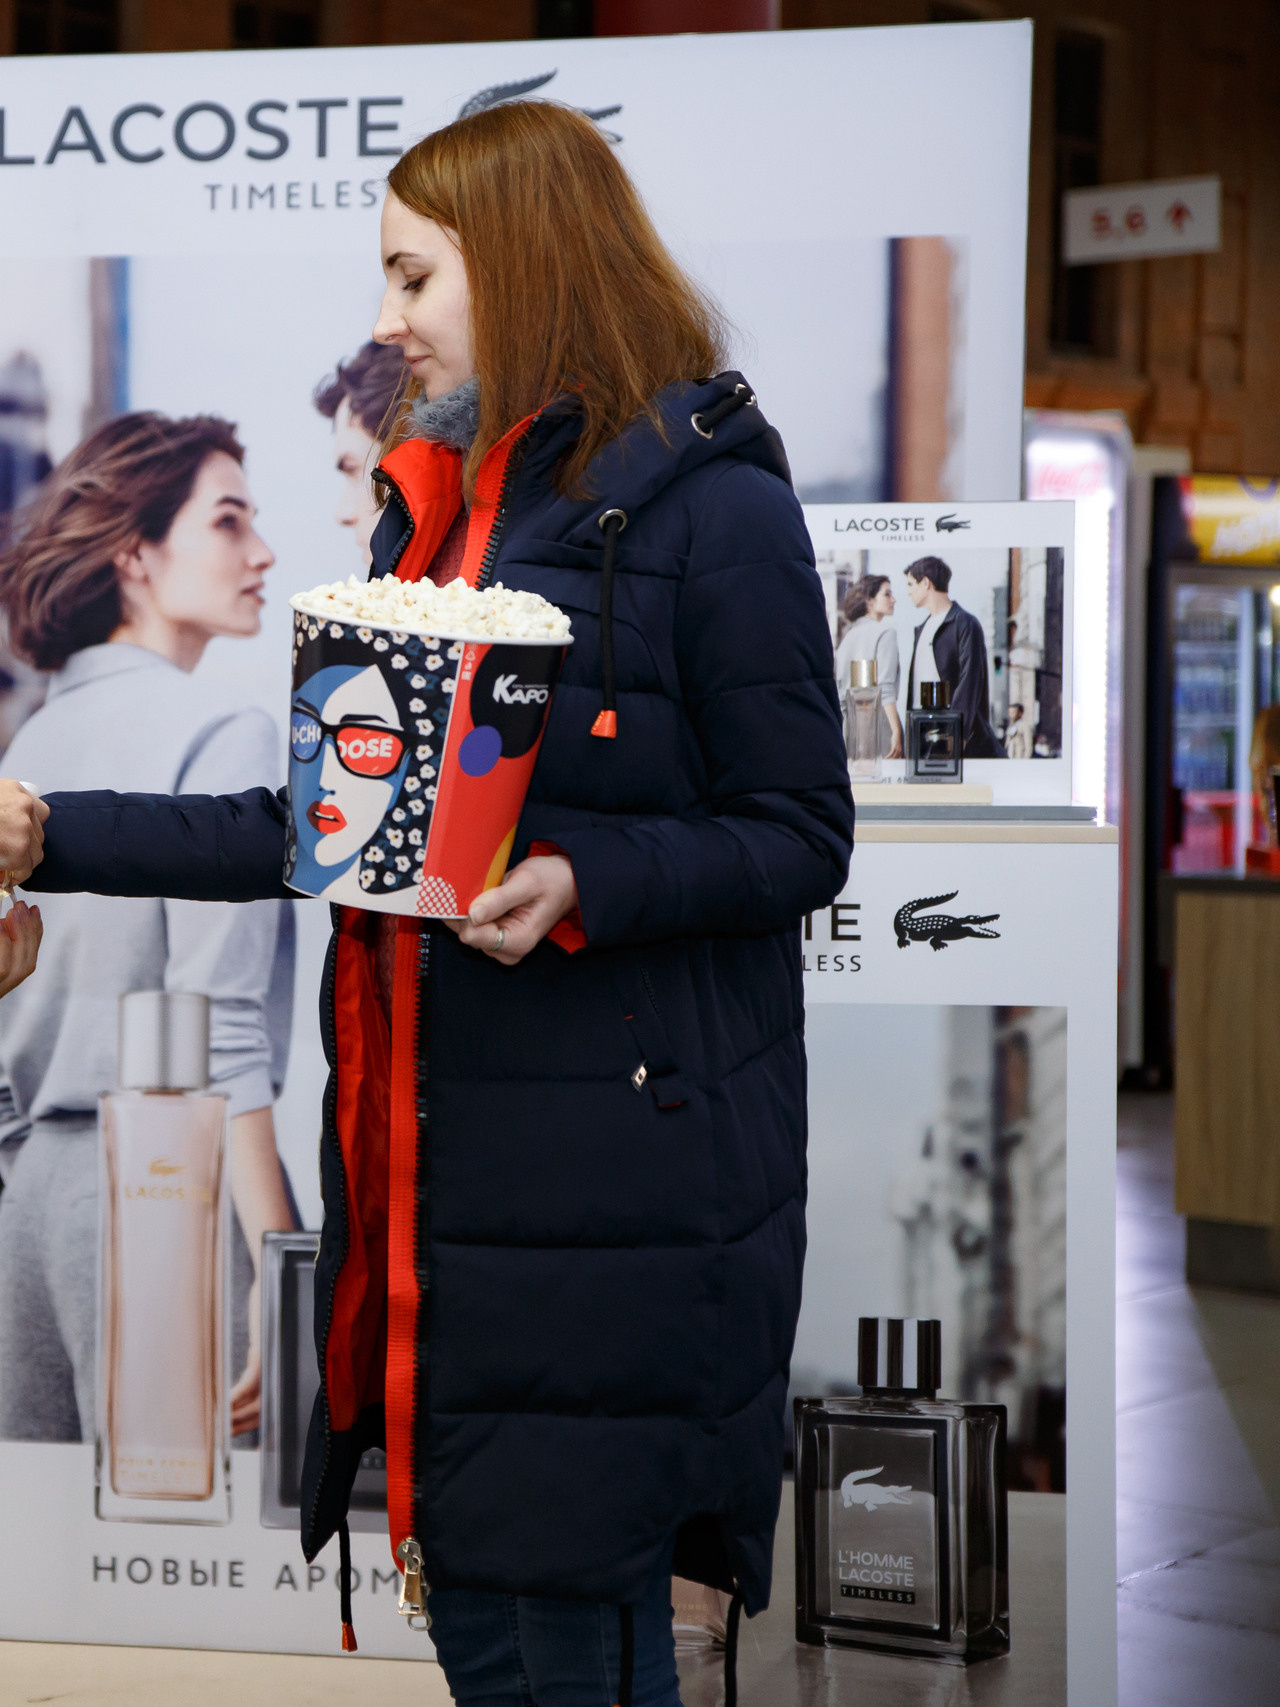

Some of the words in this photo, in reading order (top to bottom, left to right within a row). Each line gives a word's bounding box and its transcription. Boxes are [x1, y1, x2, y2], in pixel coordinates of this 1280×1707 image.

[834, 517, 925, 532] LACOSTE
[881, 534, 925, 542] TIMELESS
[838, 1549, 914, 1570] L'HOMME
[92, 1555, 244, 1588] НОВЫЕ
[838, 1566, 915, 1587] LACOSTE
[841, 1586, 913, 1603] TIMELESS
